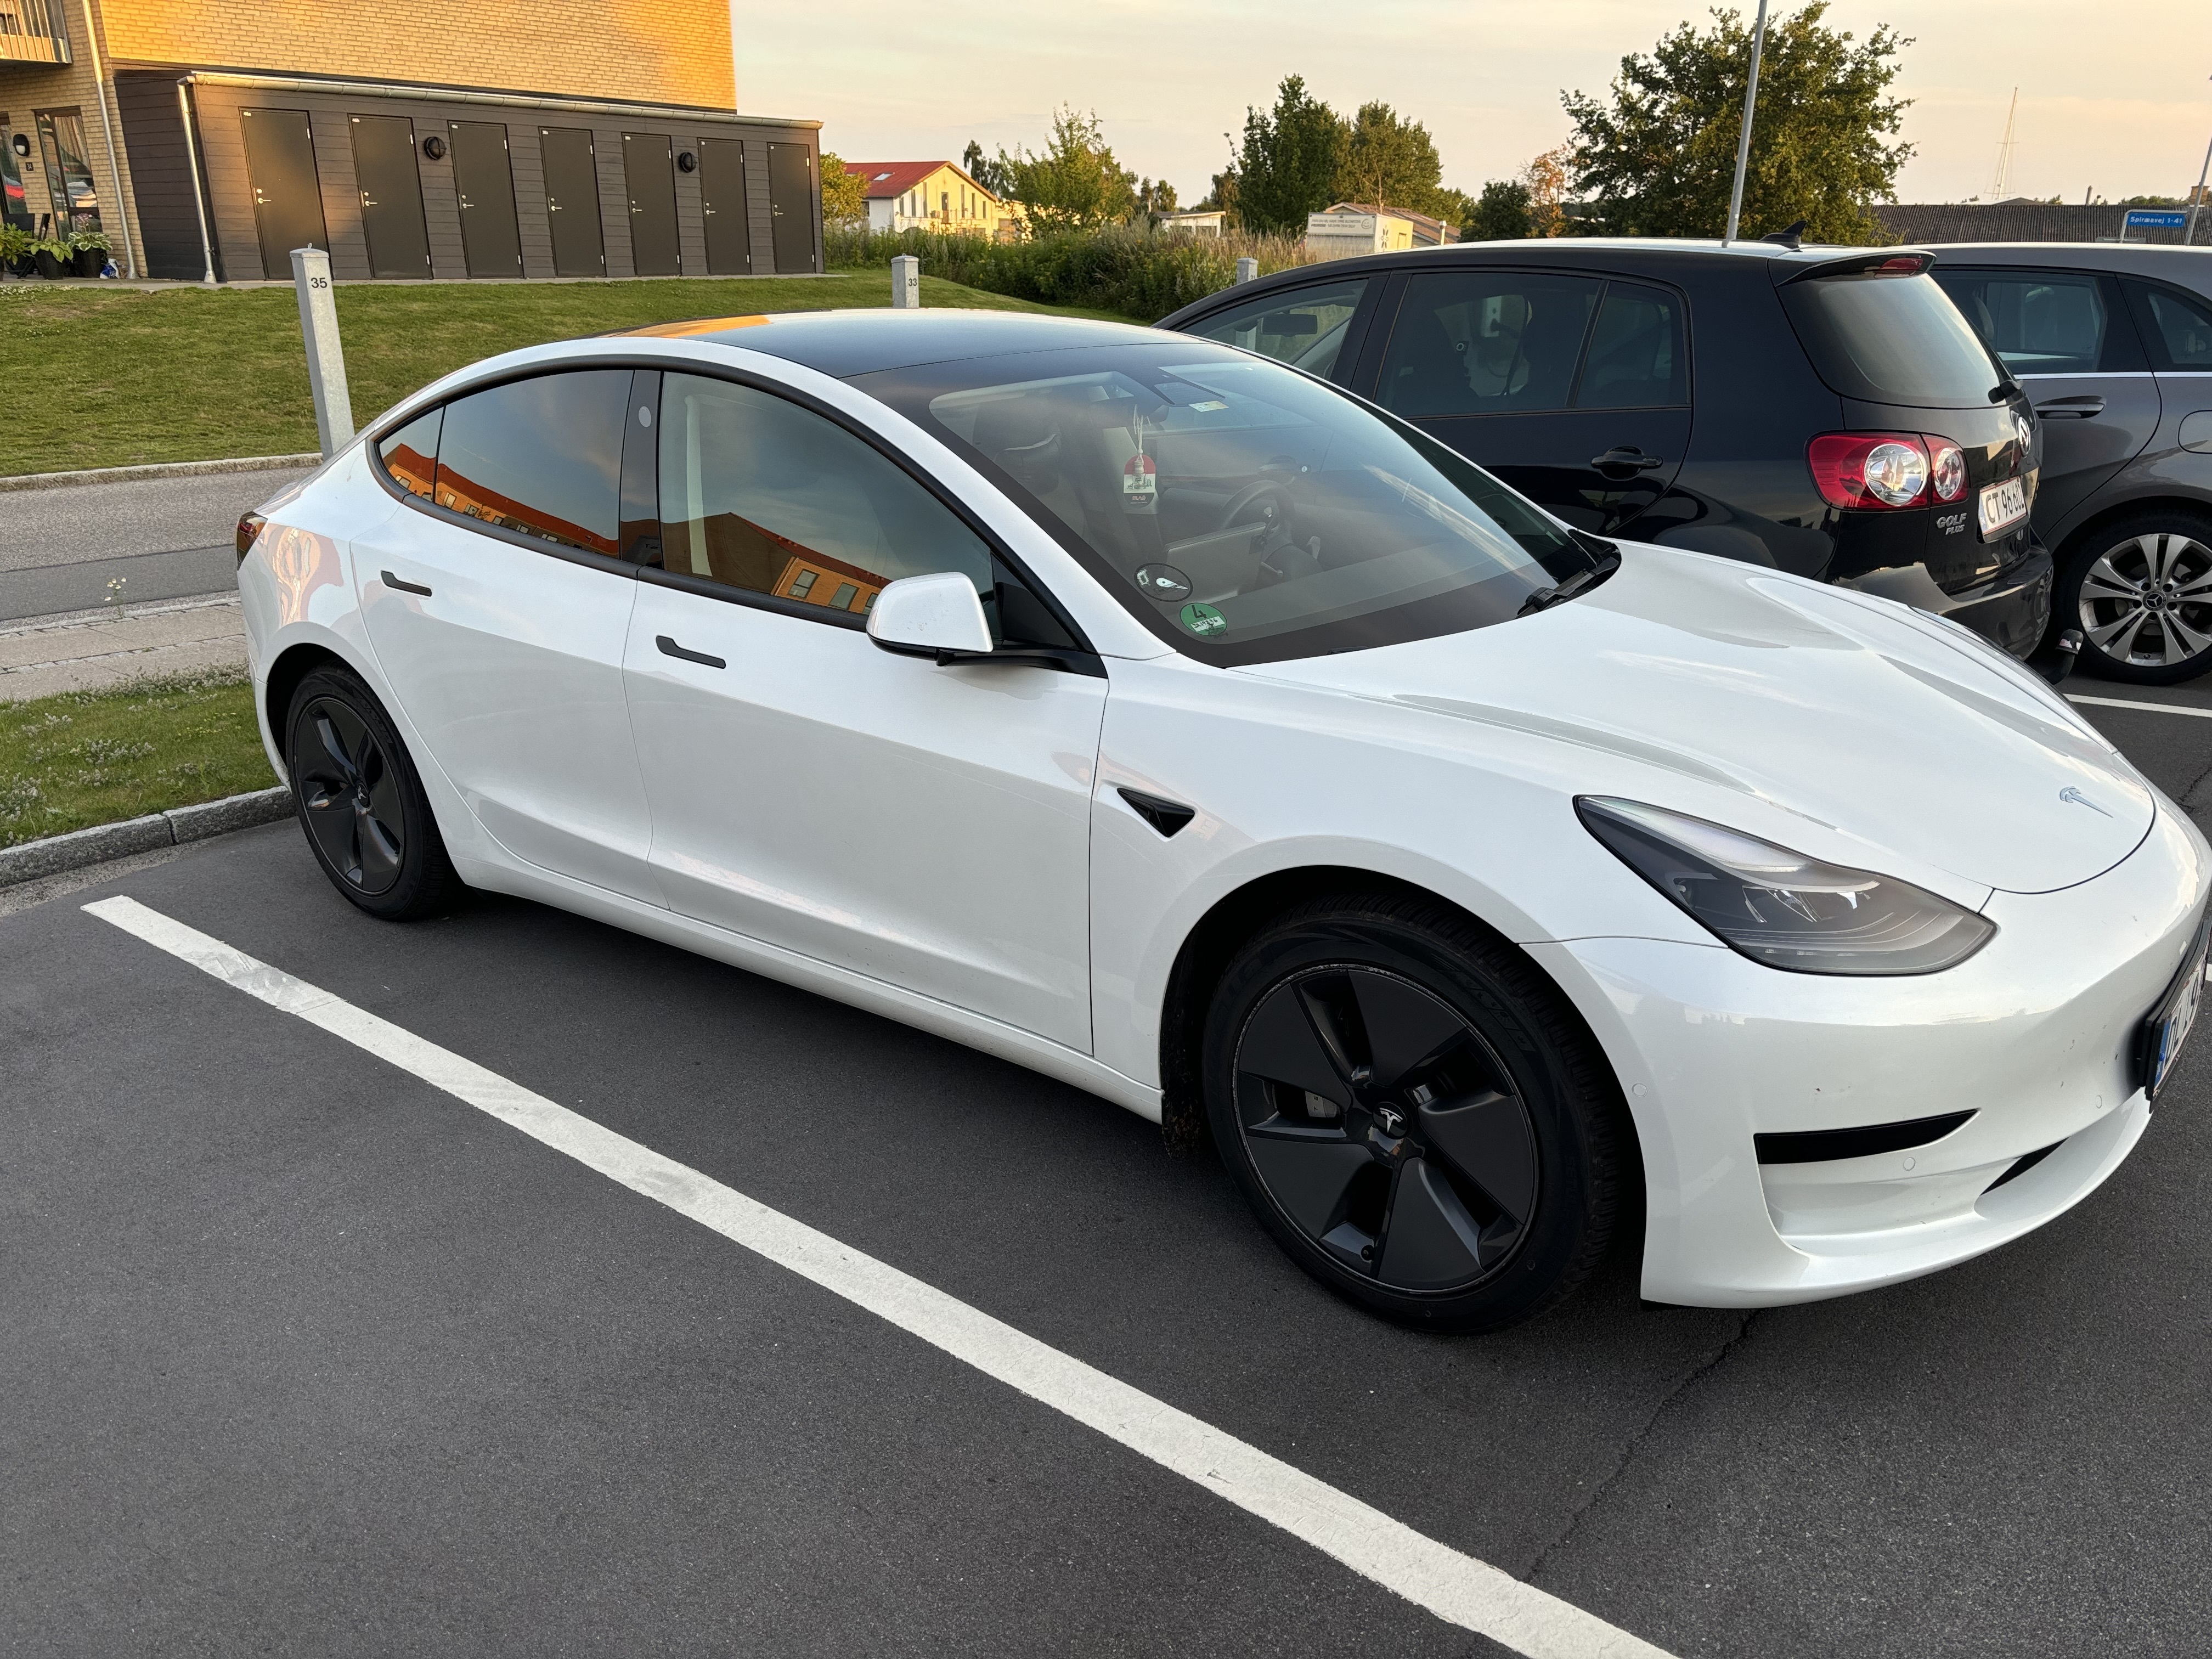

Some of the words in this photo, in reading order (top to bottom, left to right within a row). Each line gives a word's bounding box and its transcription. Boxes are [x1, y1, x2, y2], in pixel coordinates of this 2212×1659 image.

[2130, 216, 2164, 224] Spiræavej
[311, 277, 328, 289] 35
[909, 278, 917, 286] 33
[1985, 492, 2001, 523] CT
[2001, 487, 2013, 518] 96
[1936, 512, 1967, 529] GOLF
[1945, 524, 1965, 535] PLUS
[1191, 605, 1207, 619] 4
